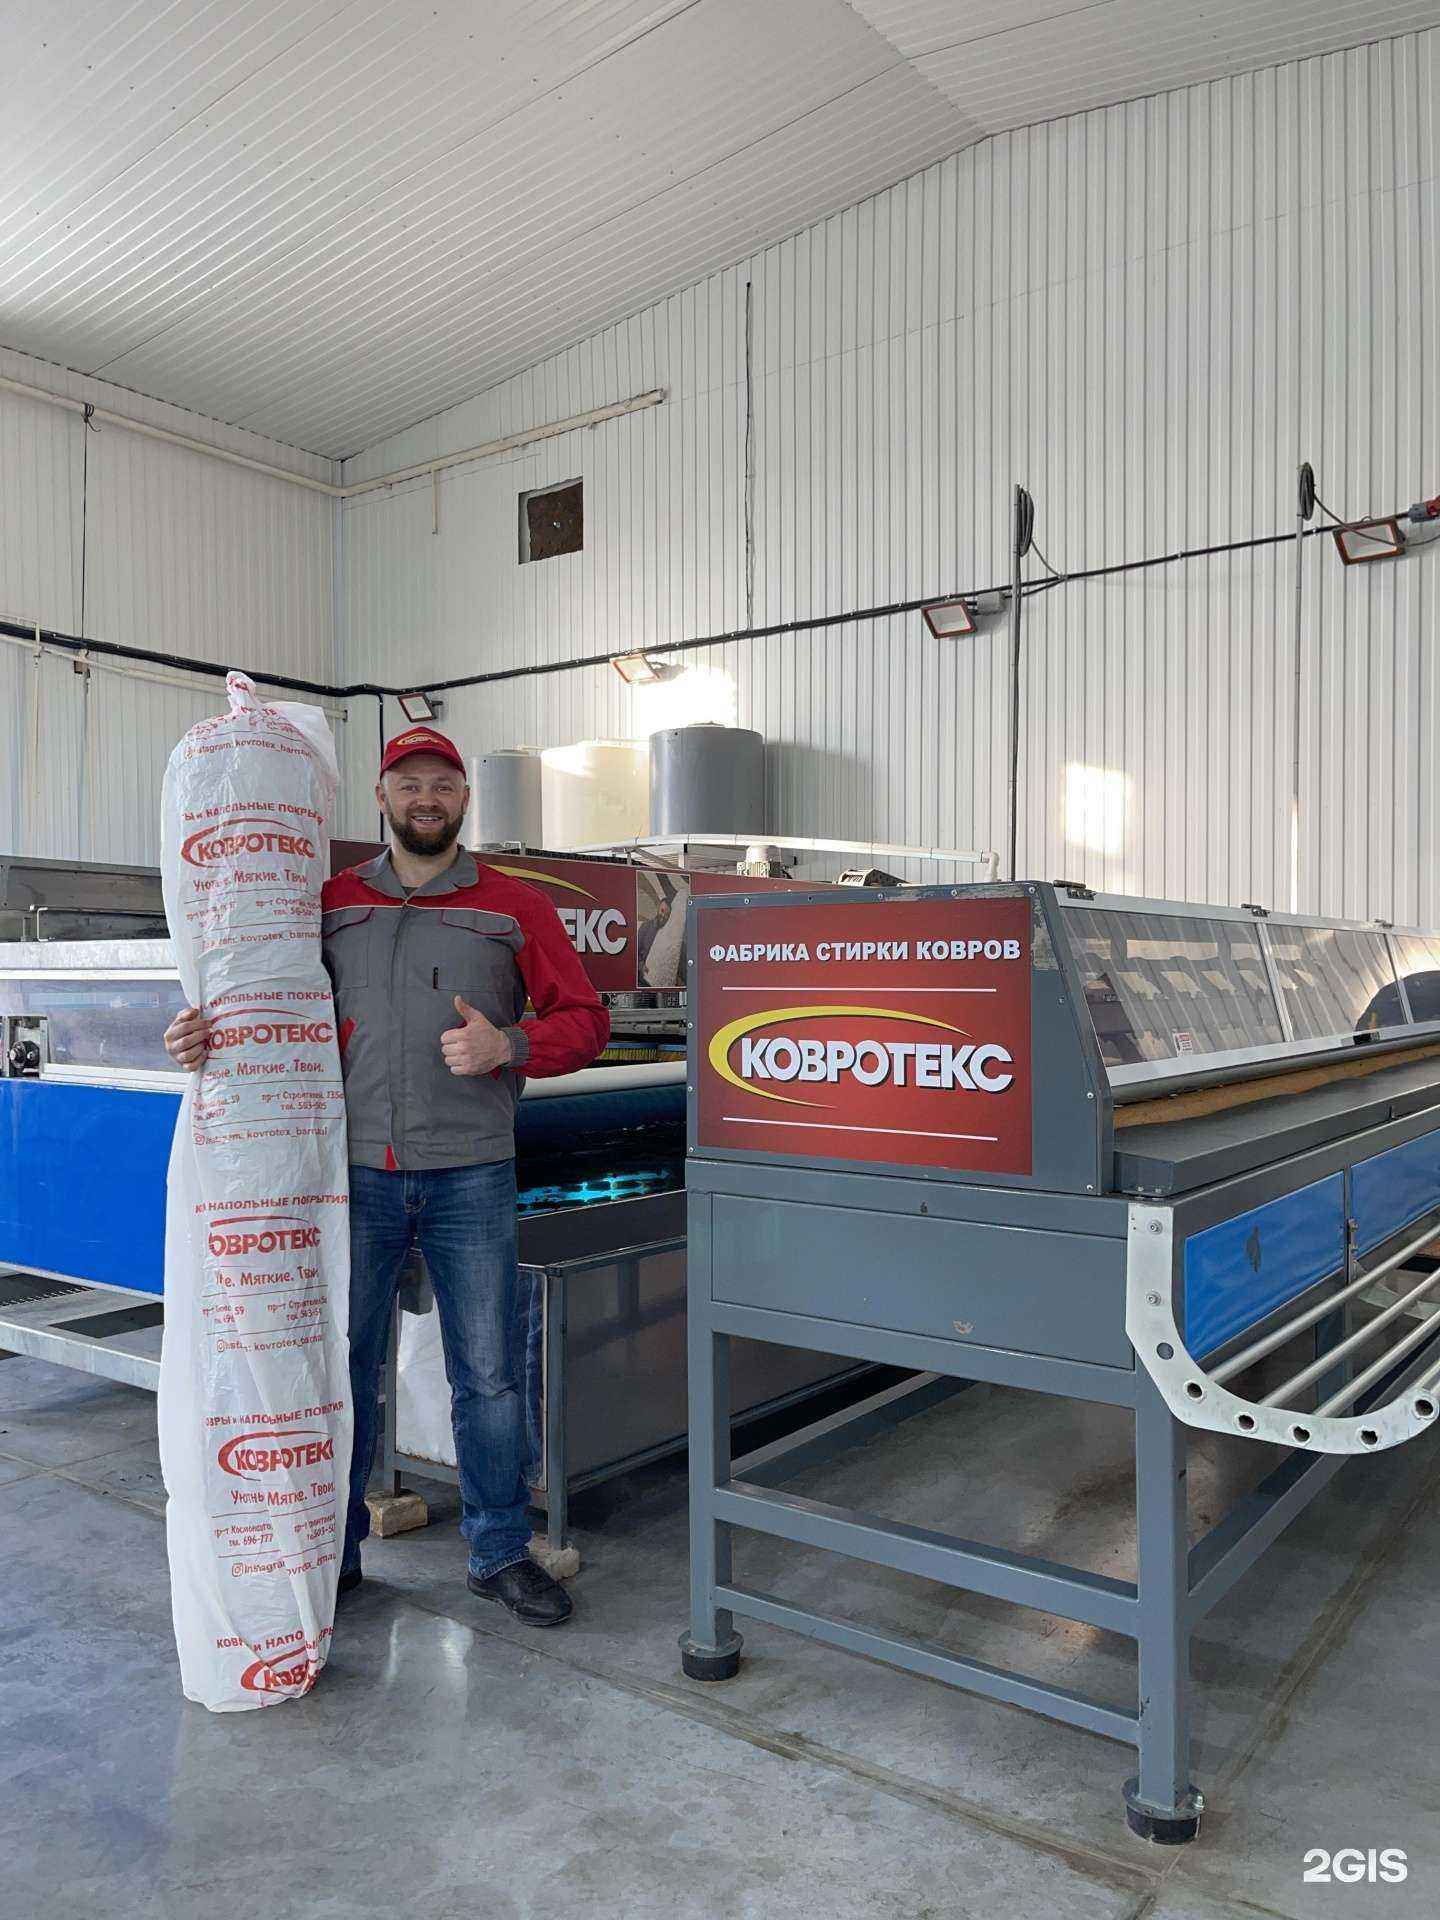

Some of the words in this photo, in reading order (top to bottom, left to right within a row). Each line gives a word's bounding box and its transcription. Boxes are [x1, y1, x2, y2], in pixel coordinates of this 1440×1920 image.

[197, 832, 316, 861] КОВРОТЕКС
[709, 943, 810, 962] ФАБРИКА
[816, 941, 909, 961] СТИРКИ
[916, 939, 1021, 960] КОВРОВ
[237, 1061, 289, 1076] Мягкие.
[293, 1059, 324, 1074] Твои.
[741, 1036, 1014, 1093] КОВРОТЕКС
[208, 1197, 289, 1211] НАПОЛЬНЫЕ
[240, 1271, 294, 1286] Мягкие.
